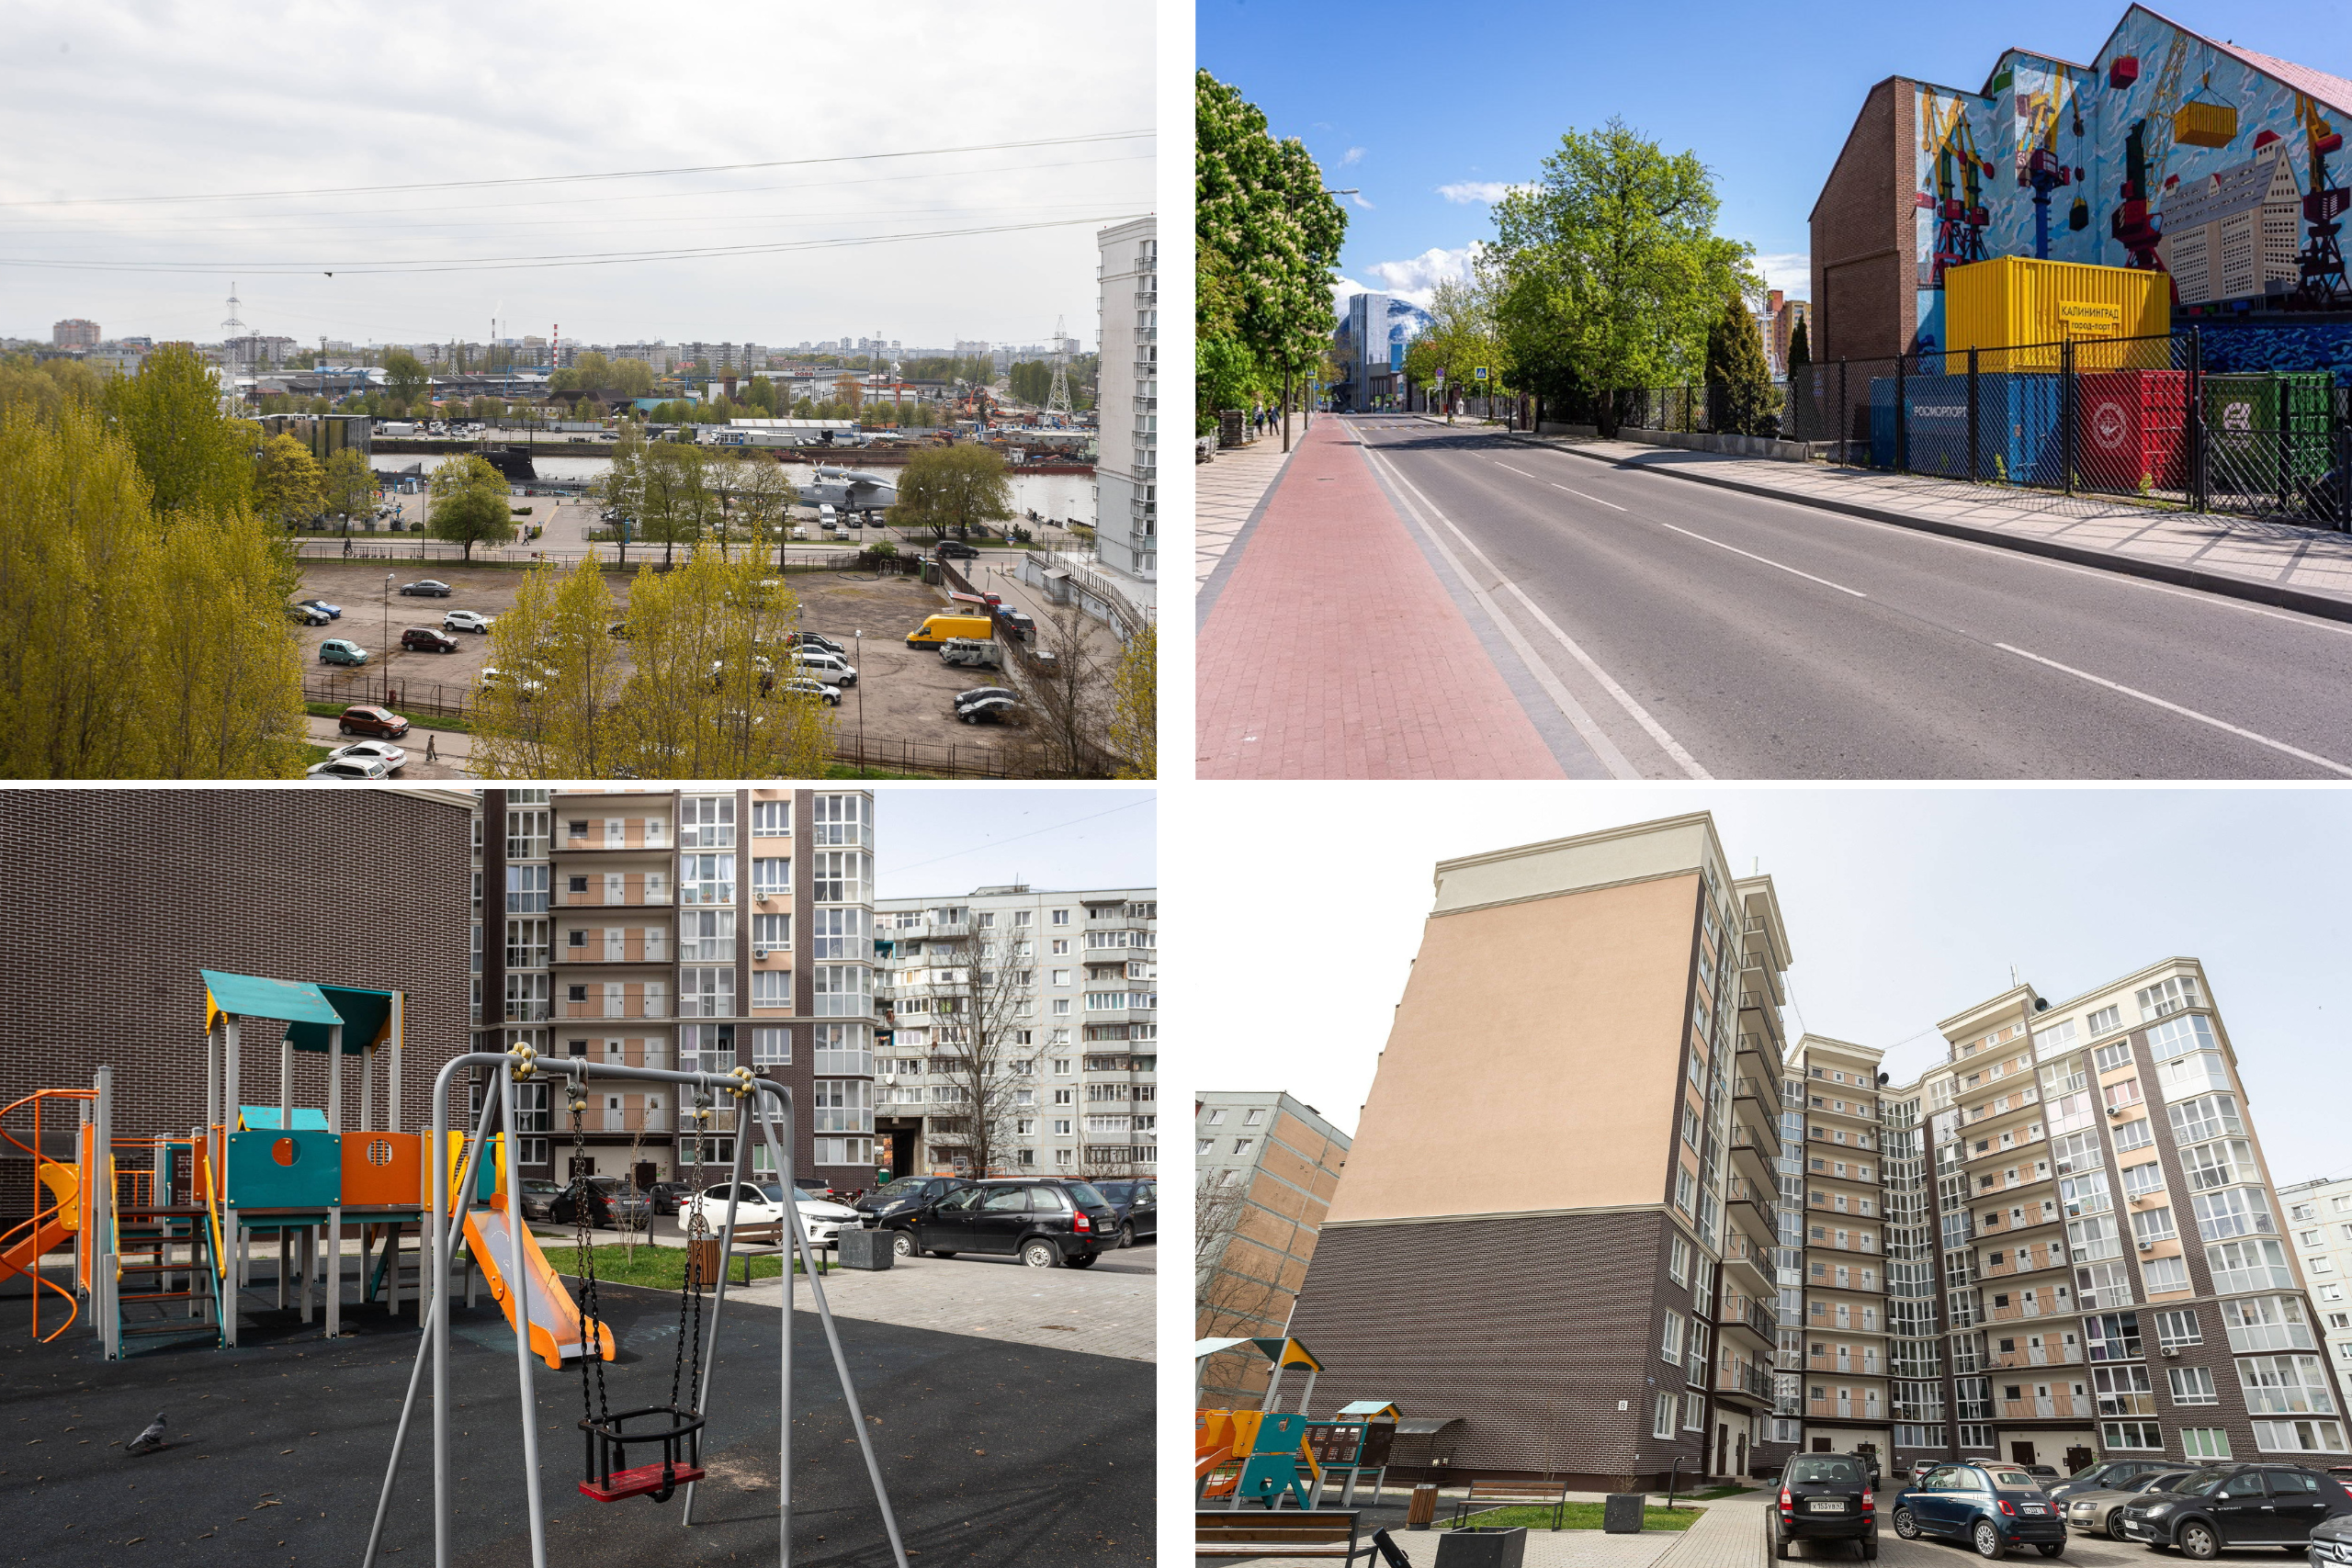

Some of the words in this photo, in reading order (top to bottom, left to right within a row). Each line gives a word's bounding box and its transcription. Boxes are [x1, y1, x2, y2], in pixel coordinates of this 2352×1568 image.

[2061, 306, 2119, 321] КАЛИНИНГРАД
[2071, 322, 2110, 332] город-порт
[1914, 406, 1967, 417] РОСМОРПОРТ
